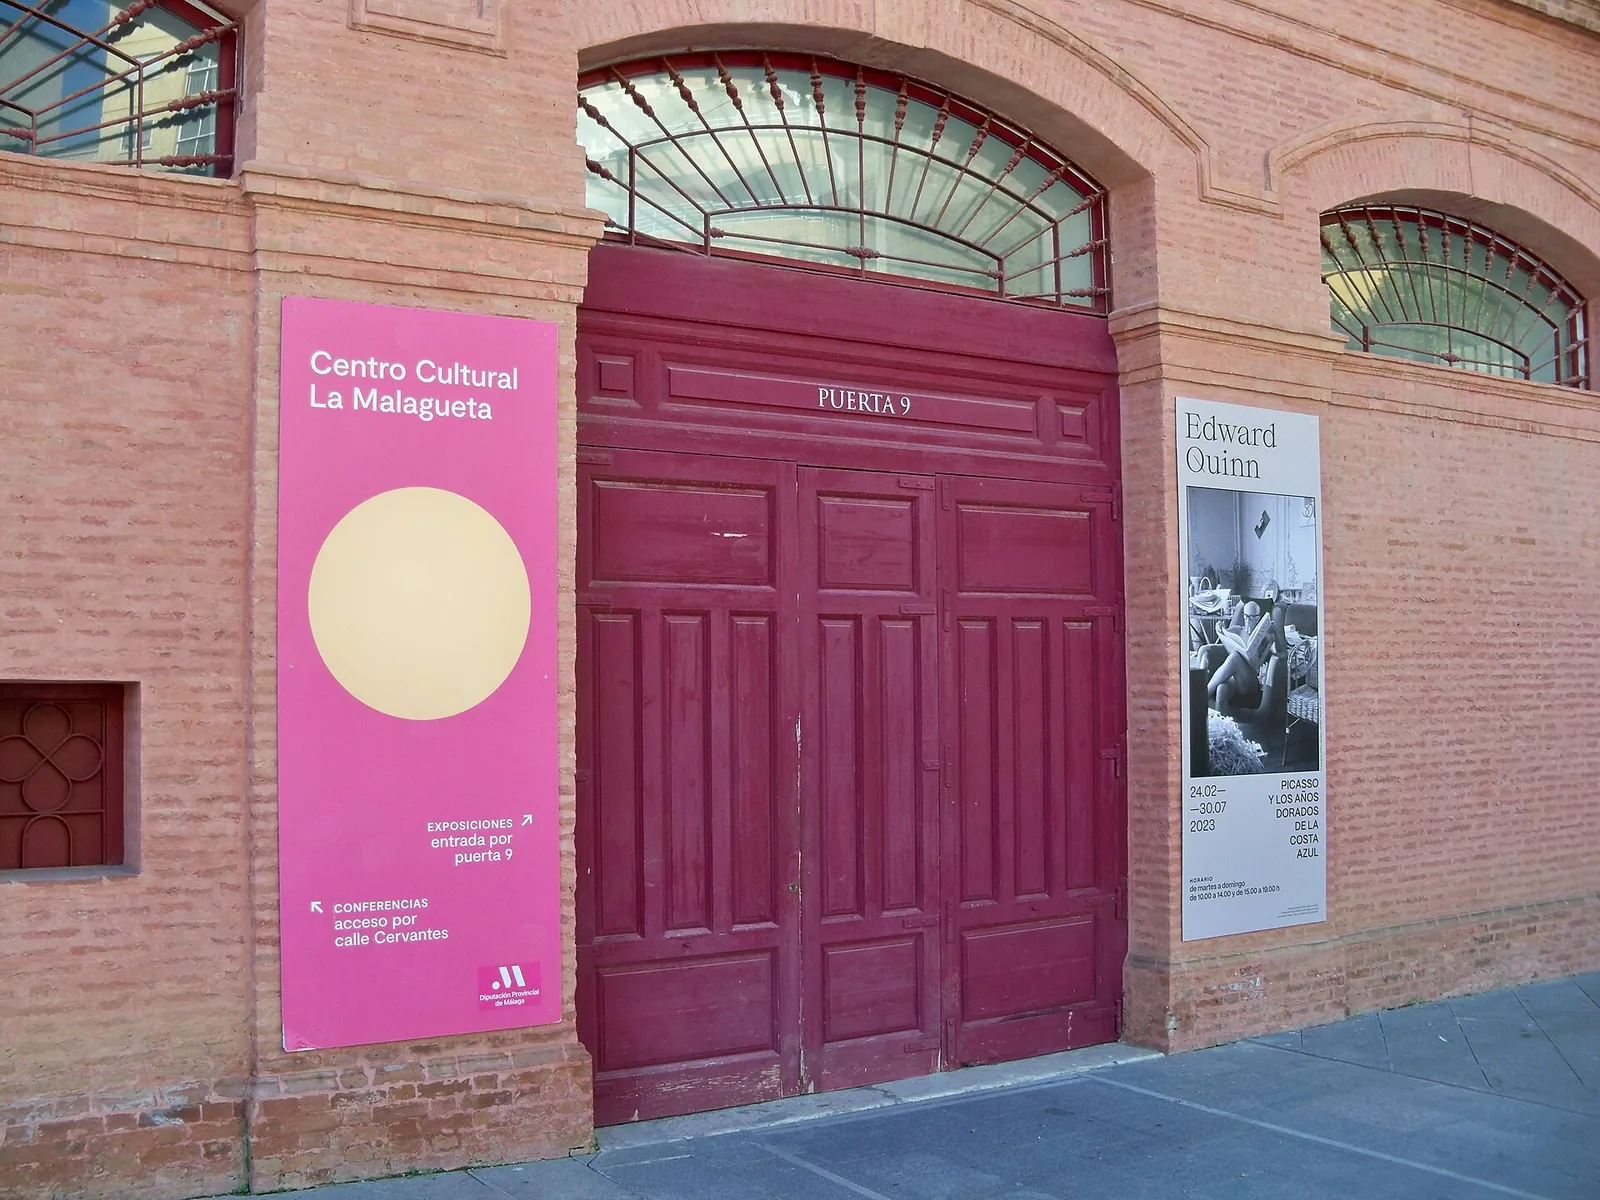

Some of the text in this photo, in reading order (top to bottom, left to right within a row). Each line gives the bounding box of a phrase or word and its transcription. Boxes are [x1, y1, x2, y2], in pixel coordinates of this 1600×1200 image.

[310, 350, 518, 390] Centro Cultural
[310, 384, 493, 422] La Malagueta
[818, 387, 911, 416] PUERTA 9
[1185, 412, 1277, 448] Edward
[1186, 446, 1261, 479] Quinn
[1281, 778, 1319, 790] PICASSO
[1268, 790, 1319, 805] Y LOS AÑOS
[1276, 806, 1319, 819] DORADOS
[427, 818, 513, 832] EXPOSICIONES
[1190, 819, 1216, 832] 2023
[1295, 820, 1319, 831] DE LA
[431, 832, 513, 850] entrada por
[1289, 834, 1319, 846] COSTA
[455, 848, 513, 866] puerta 9
[1296, 848, 1319, 859] AZUL
[1222, 881, 1245, 889] domingo
[334, 898, 429, 914] CONFERENCIAS
[334, 914, 417, 931] acceso por
[335, 928, 449, 947] calle Cervantes
[479, 988, 540, 1001] Diputación Provincial
